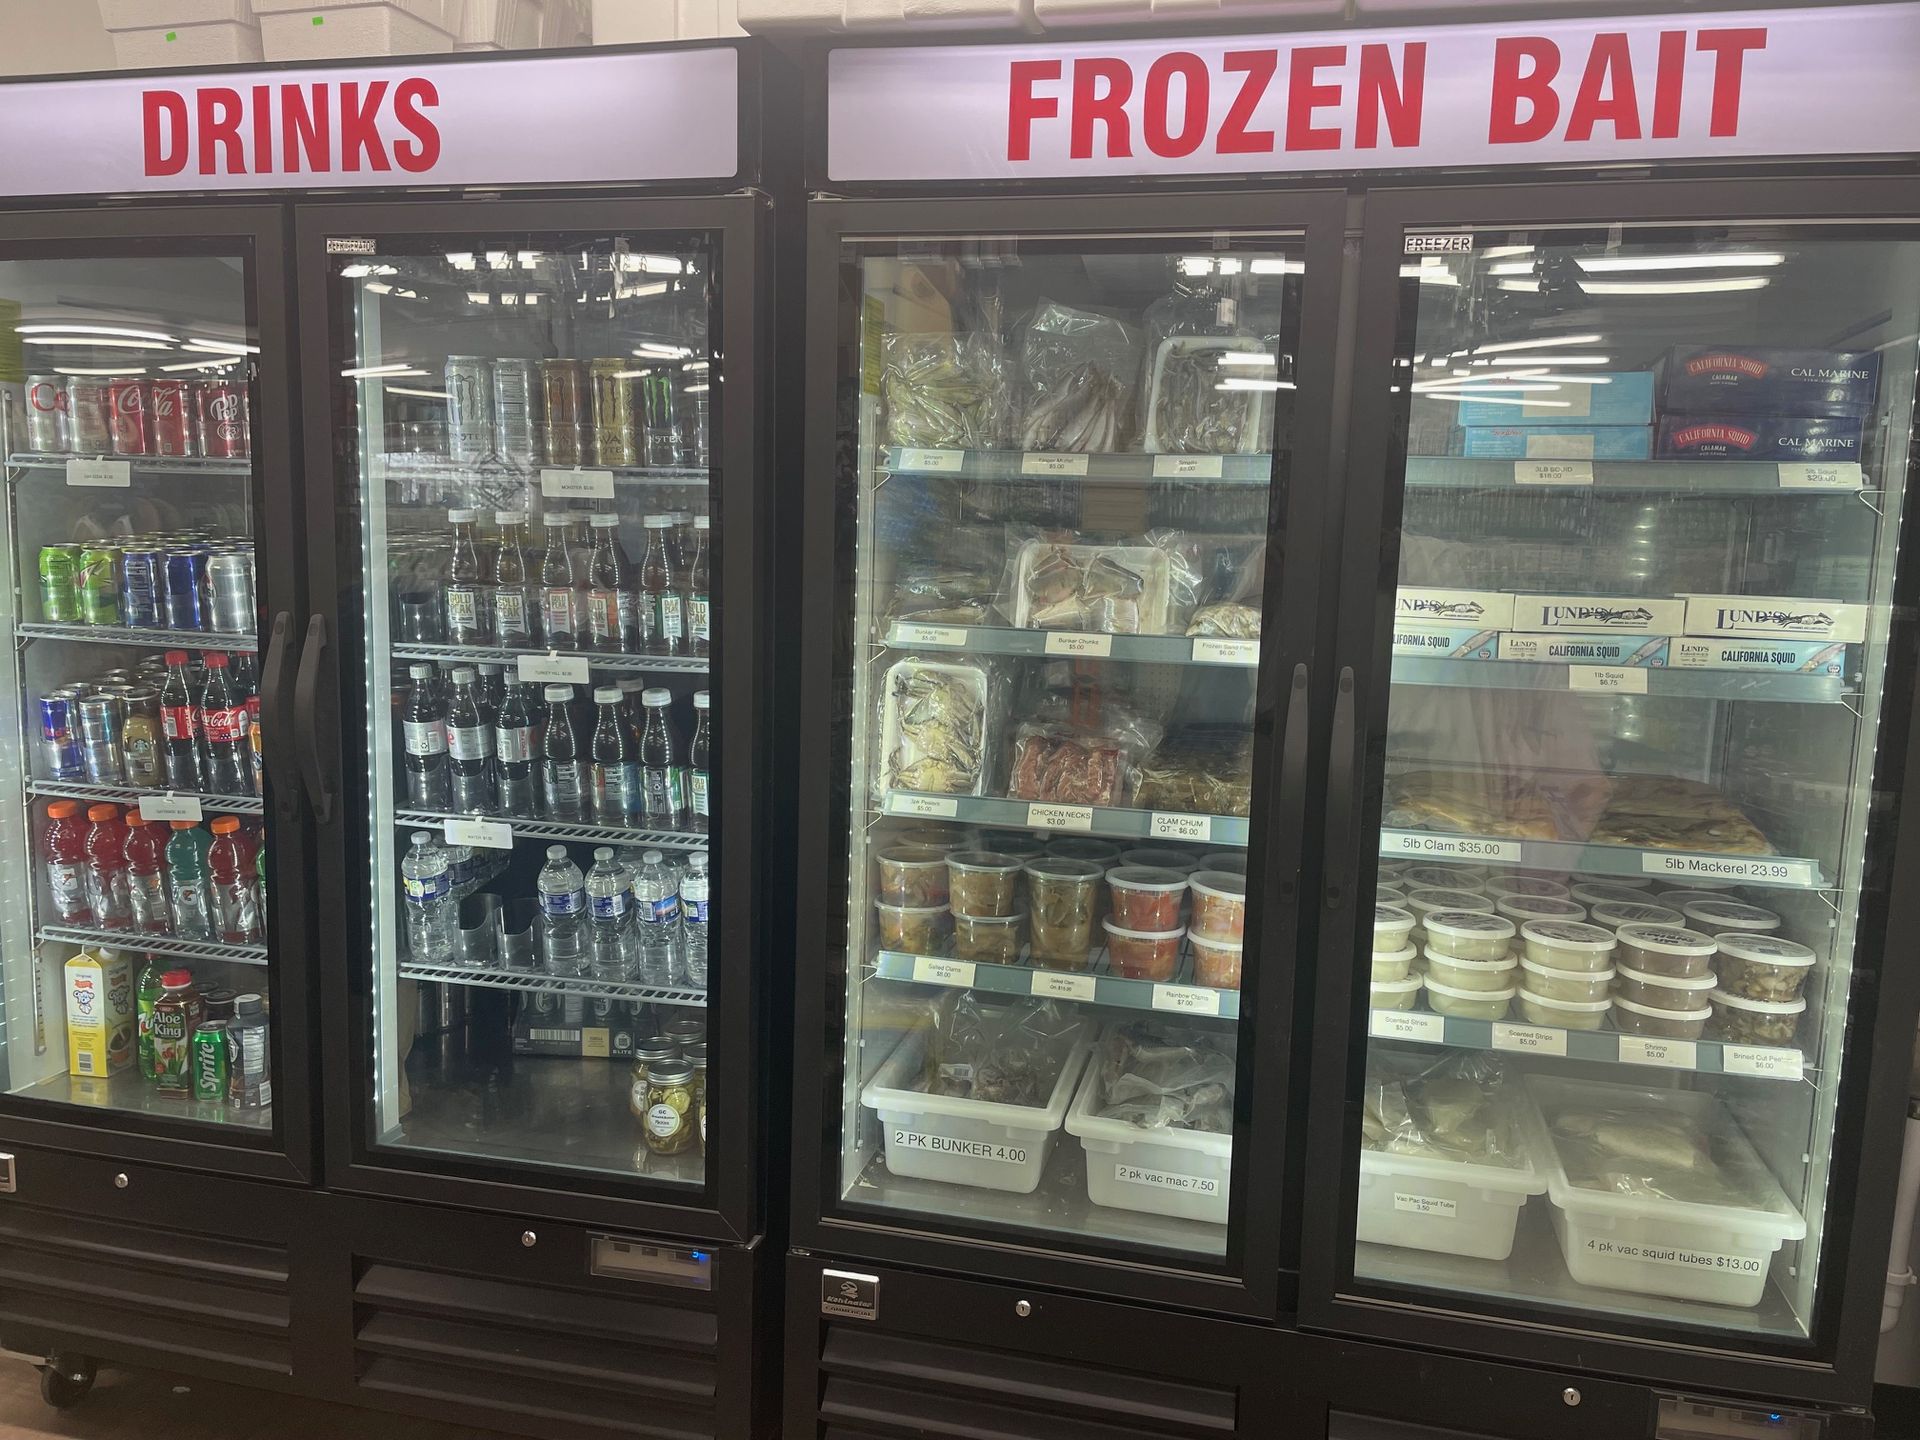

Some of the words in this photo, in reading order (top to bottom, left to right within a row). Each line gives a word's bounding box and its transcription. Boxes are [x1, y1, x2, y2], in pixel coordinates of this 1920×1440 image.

[1007, 41, 1427, 161] FROZEN
[1488, 27, 1767, 145] BAIT
[142, 78, 441, 177] DRINKS
[1406, 237, 1470, 251] FREEZER
[1690, 355, 1737, 373] CALIFORNIA
[1740, 359, 1764, 375] SQUID
[1791, 368, 1813, 377] CAL
[1818, 369, 1869, 379] MARINE
[1679, 427, 1724, 444] CALIFORNIA
[1728, 430, 1751, 446] SQUID
[1778, 437, 1801, 446] CAL
[1805, 438, 1855, 448] MARINE
[1396, 598, 1439, 612] UND'S
[1428, 636, 1450, 648] SQUID
[1509, 639, 1537, 648] LUND'S
[1681, 644, 1710, 652] LUND'S
[1549, 645, 1595, 657] CALIFORNIA
[1596, 646, 1620, 658] SQUID
[1721, 650, 1769, 662] CALIFORNIA
[1771, 651, 1796, 664] SQUID
[1031, 808, 1064, 818] CHICKEN
[1065, 810, 1091, 820] NECKS
[1047, 818, 1066, 826] $3.00
[1157, 817, 1179, 825] CLAM
[1180, 819, 1203, 827] CHUM
[1179, 828, 1199, 836] $6.00
[1402, 837, 1421, 849] 5lb
[1424, 839, 1456, 852] Clam
[1458, 841, 1500, 856] $35.00
[1665, 858, 1685, 870] 5lb
[1688, 859, 1749, 876] Mackerel
[1751, 863, 1788, 878] 23.99
[1166, 991, 1190, 999] Rainbow
[1190, 993, 1209, 1001] Clams
[154, 1012, 181, 1024] Aloe
[1385, 1016, 1410, 1025] Scented
[1410, 1018, 1428, 1027] Strips
[154, 1024, 182, 1037] King
[1508, 1029, 1534, 1039] Scented
[1535, 1032, 1553, 1041] Strips
[1519, 1038, 1537, 1046] $5.00
[1644, 1043, 1668, 1052] Shrimp
[1646, 1051, 1665, 1059] $5.00
[1734, 1052, 1755, 1061] Brined
[200, 1042, 217, 1092] Sprite
[895, 1131, 904, 1144] 2
[908, 1133, 927, 1148] PK
[931, 1137, 993, 1158] BUNKER
[996, 1146, 1026, 1163] 4.00
[1119, 1167, 1126, 1177] 2
[1129, 1169, 1142, 1182] pk
[1144, 1173, 1163, 1184] vac
[1166, 1176, 1189, 1188] mac
[1191, 1178, 1215, 1192] 7.50
[1587, 1240, 1595, 1249] 4
[1599, 1242, 1613, 1255] pk
[1617, 1245, 1638, 1256] vac
[1642, 1248, 1675, 1261] squid
[1679, 1252, 1712, 1266] tubes
[1716, 1256, 1760, 1272] $13.00
